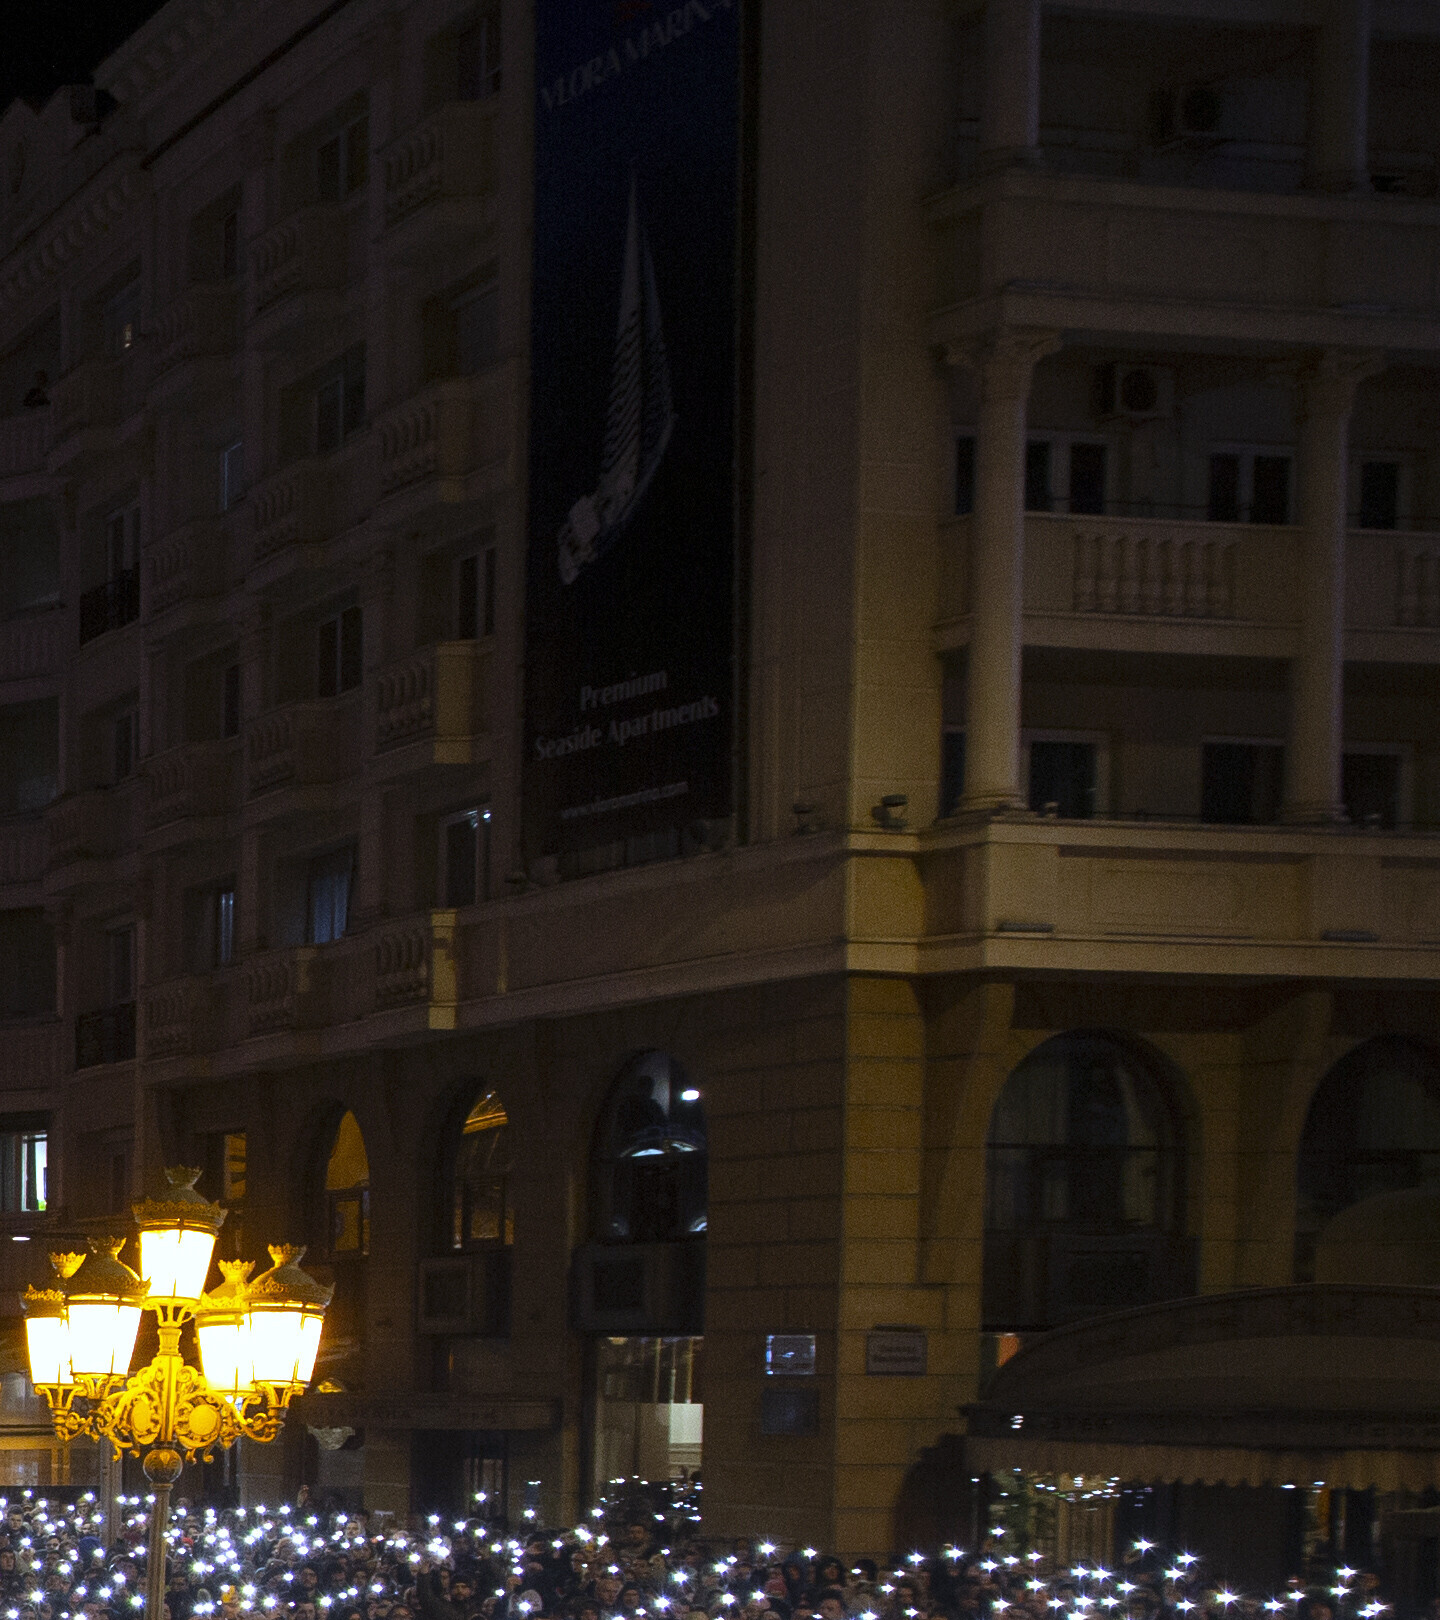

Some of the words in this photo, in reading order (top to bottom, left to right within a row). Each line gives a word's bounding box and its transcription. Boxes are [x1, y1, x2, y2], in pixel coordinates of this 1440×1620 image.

[580, 670, 668, 712] Premium
[535, 724, 602, 760] Seaside
[610, 694, 720, 747] Apartments
